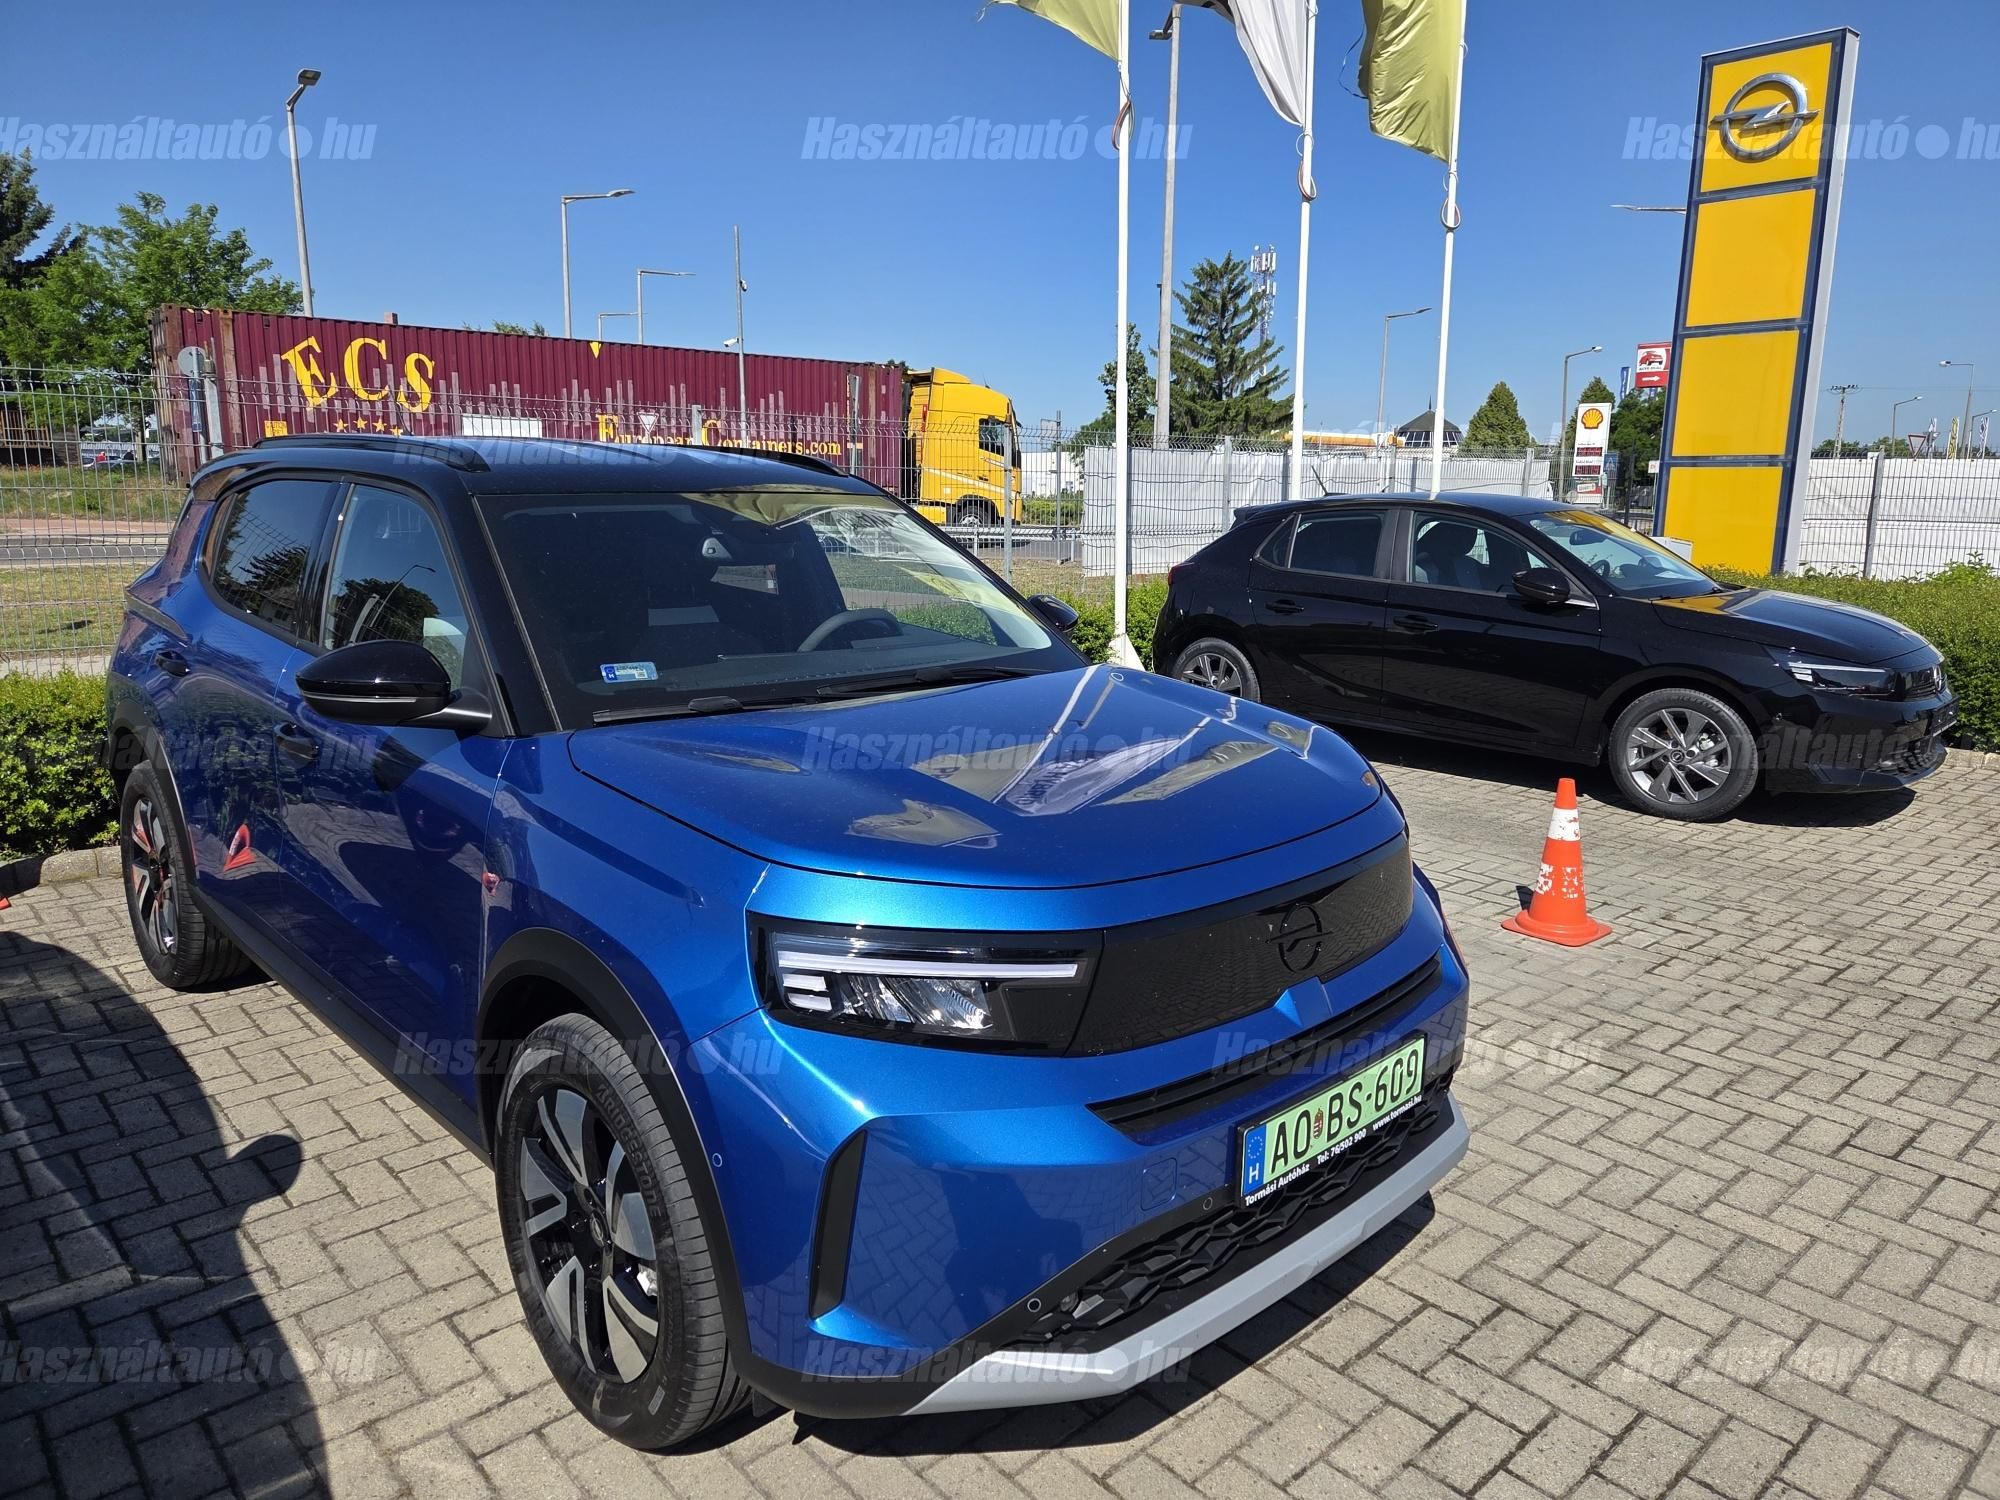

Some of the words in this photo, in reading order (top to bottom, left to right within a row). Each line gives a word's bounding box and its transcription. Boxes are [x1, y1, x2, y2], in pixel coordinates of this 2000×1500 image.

[282, 336, 435, 413] ECS
[595, 1082, 662, 1218] BRIDGESTONE
[1244, 1180, 1277, 1207] Tormási
[1278, 1163, 1310, 1189] Autóház
[1316, 1152, 1330, 1166] Tel:
[1353, 1128, 1367, 1143] 900
[1248, 1162, 1260, 1184] H
